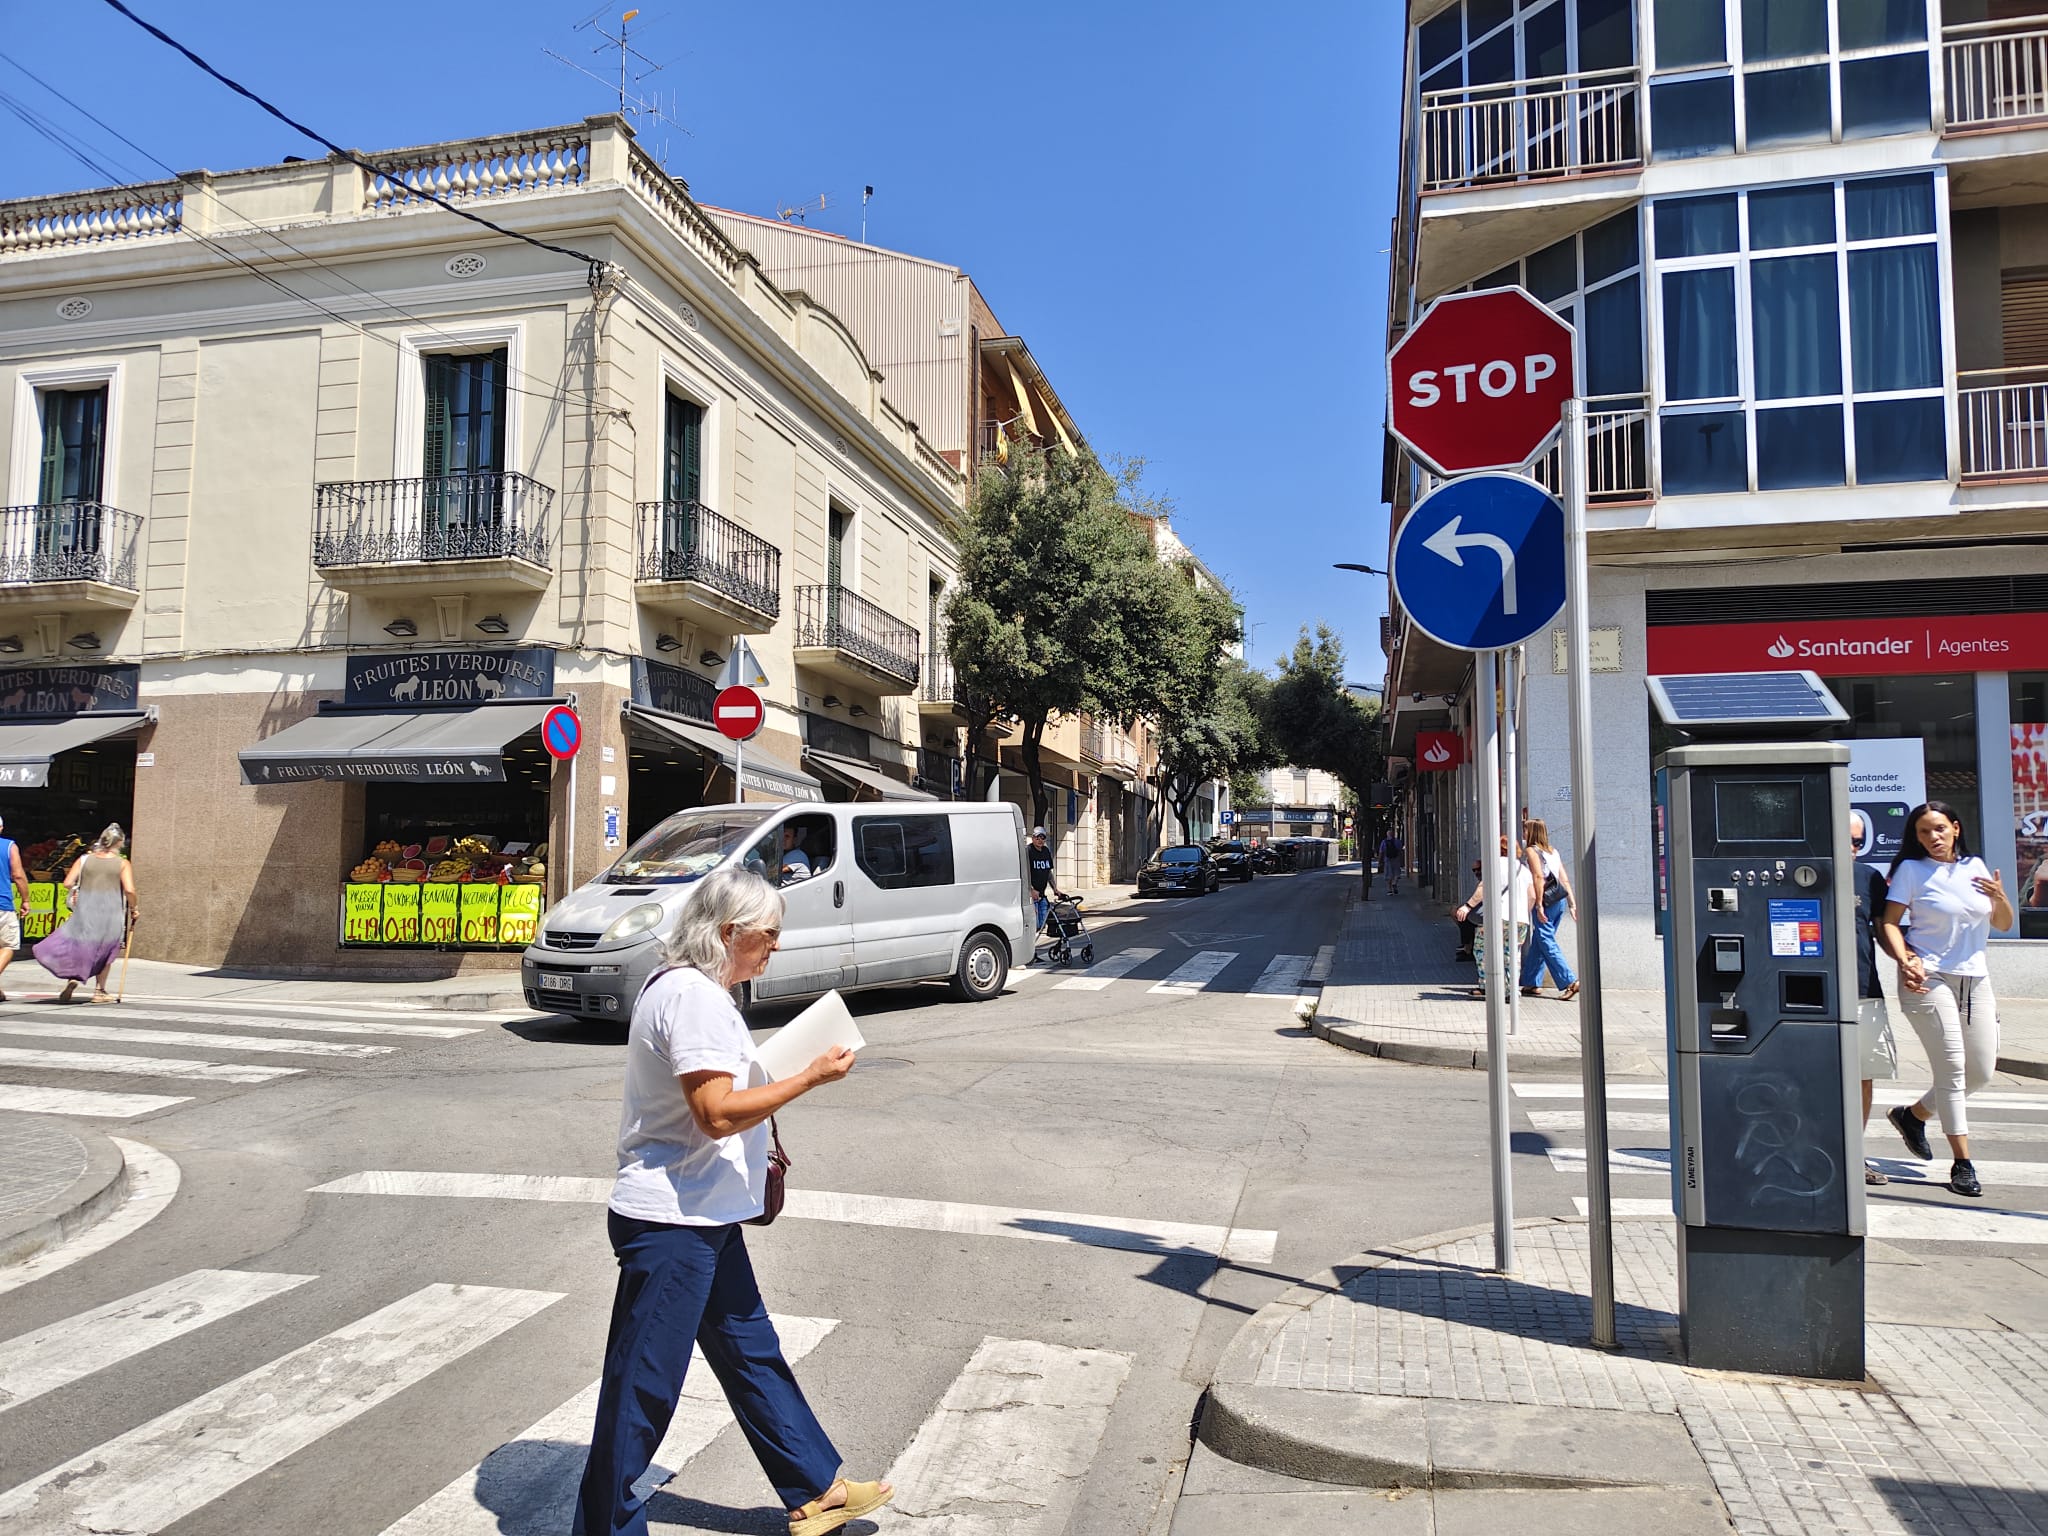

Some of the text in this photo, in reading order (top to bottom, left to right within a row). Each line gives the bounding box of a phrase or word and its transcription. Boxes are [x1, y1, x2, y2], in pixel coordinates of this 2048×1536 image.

[1408, 353, 1557, 408] STOP
[1798, 637, 2010, 656] Santander Agentes
[353, 654, 547, 691] FRUITES I VERDURES
[38, 669, 43, 686] I
[48, 669, 133, 700] VERDURES
[422, 673, 474, 701] LEÓN
[26, 687, 70, 713] LEÓN
[276, 761, 465, 778] FRUITES I VERDURES LEÓN
[1850, 772, 1899, 782] Santander
[765, 778, 794, 796] VERDURES
[794, 786, 809, 799] LEÓN
[1874, 783, 1906, 792] desde:
[1223, 812, 1232, 823] P
[423, 887, 455, 905] BANANA
